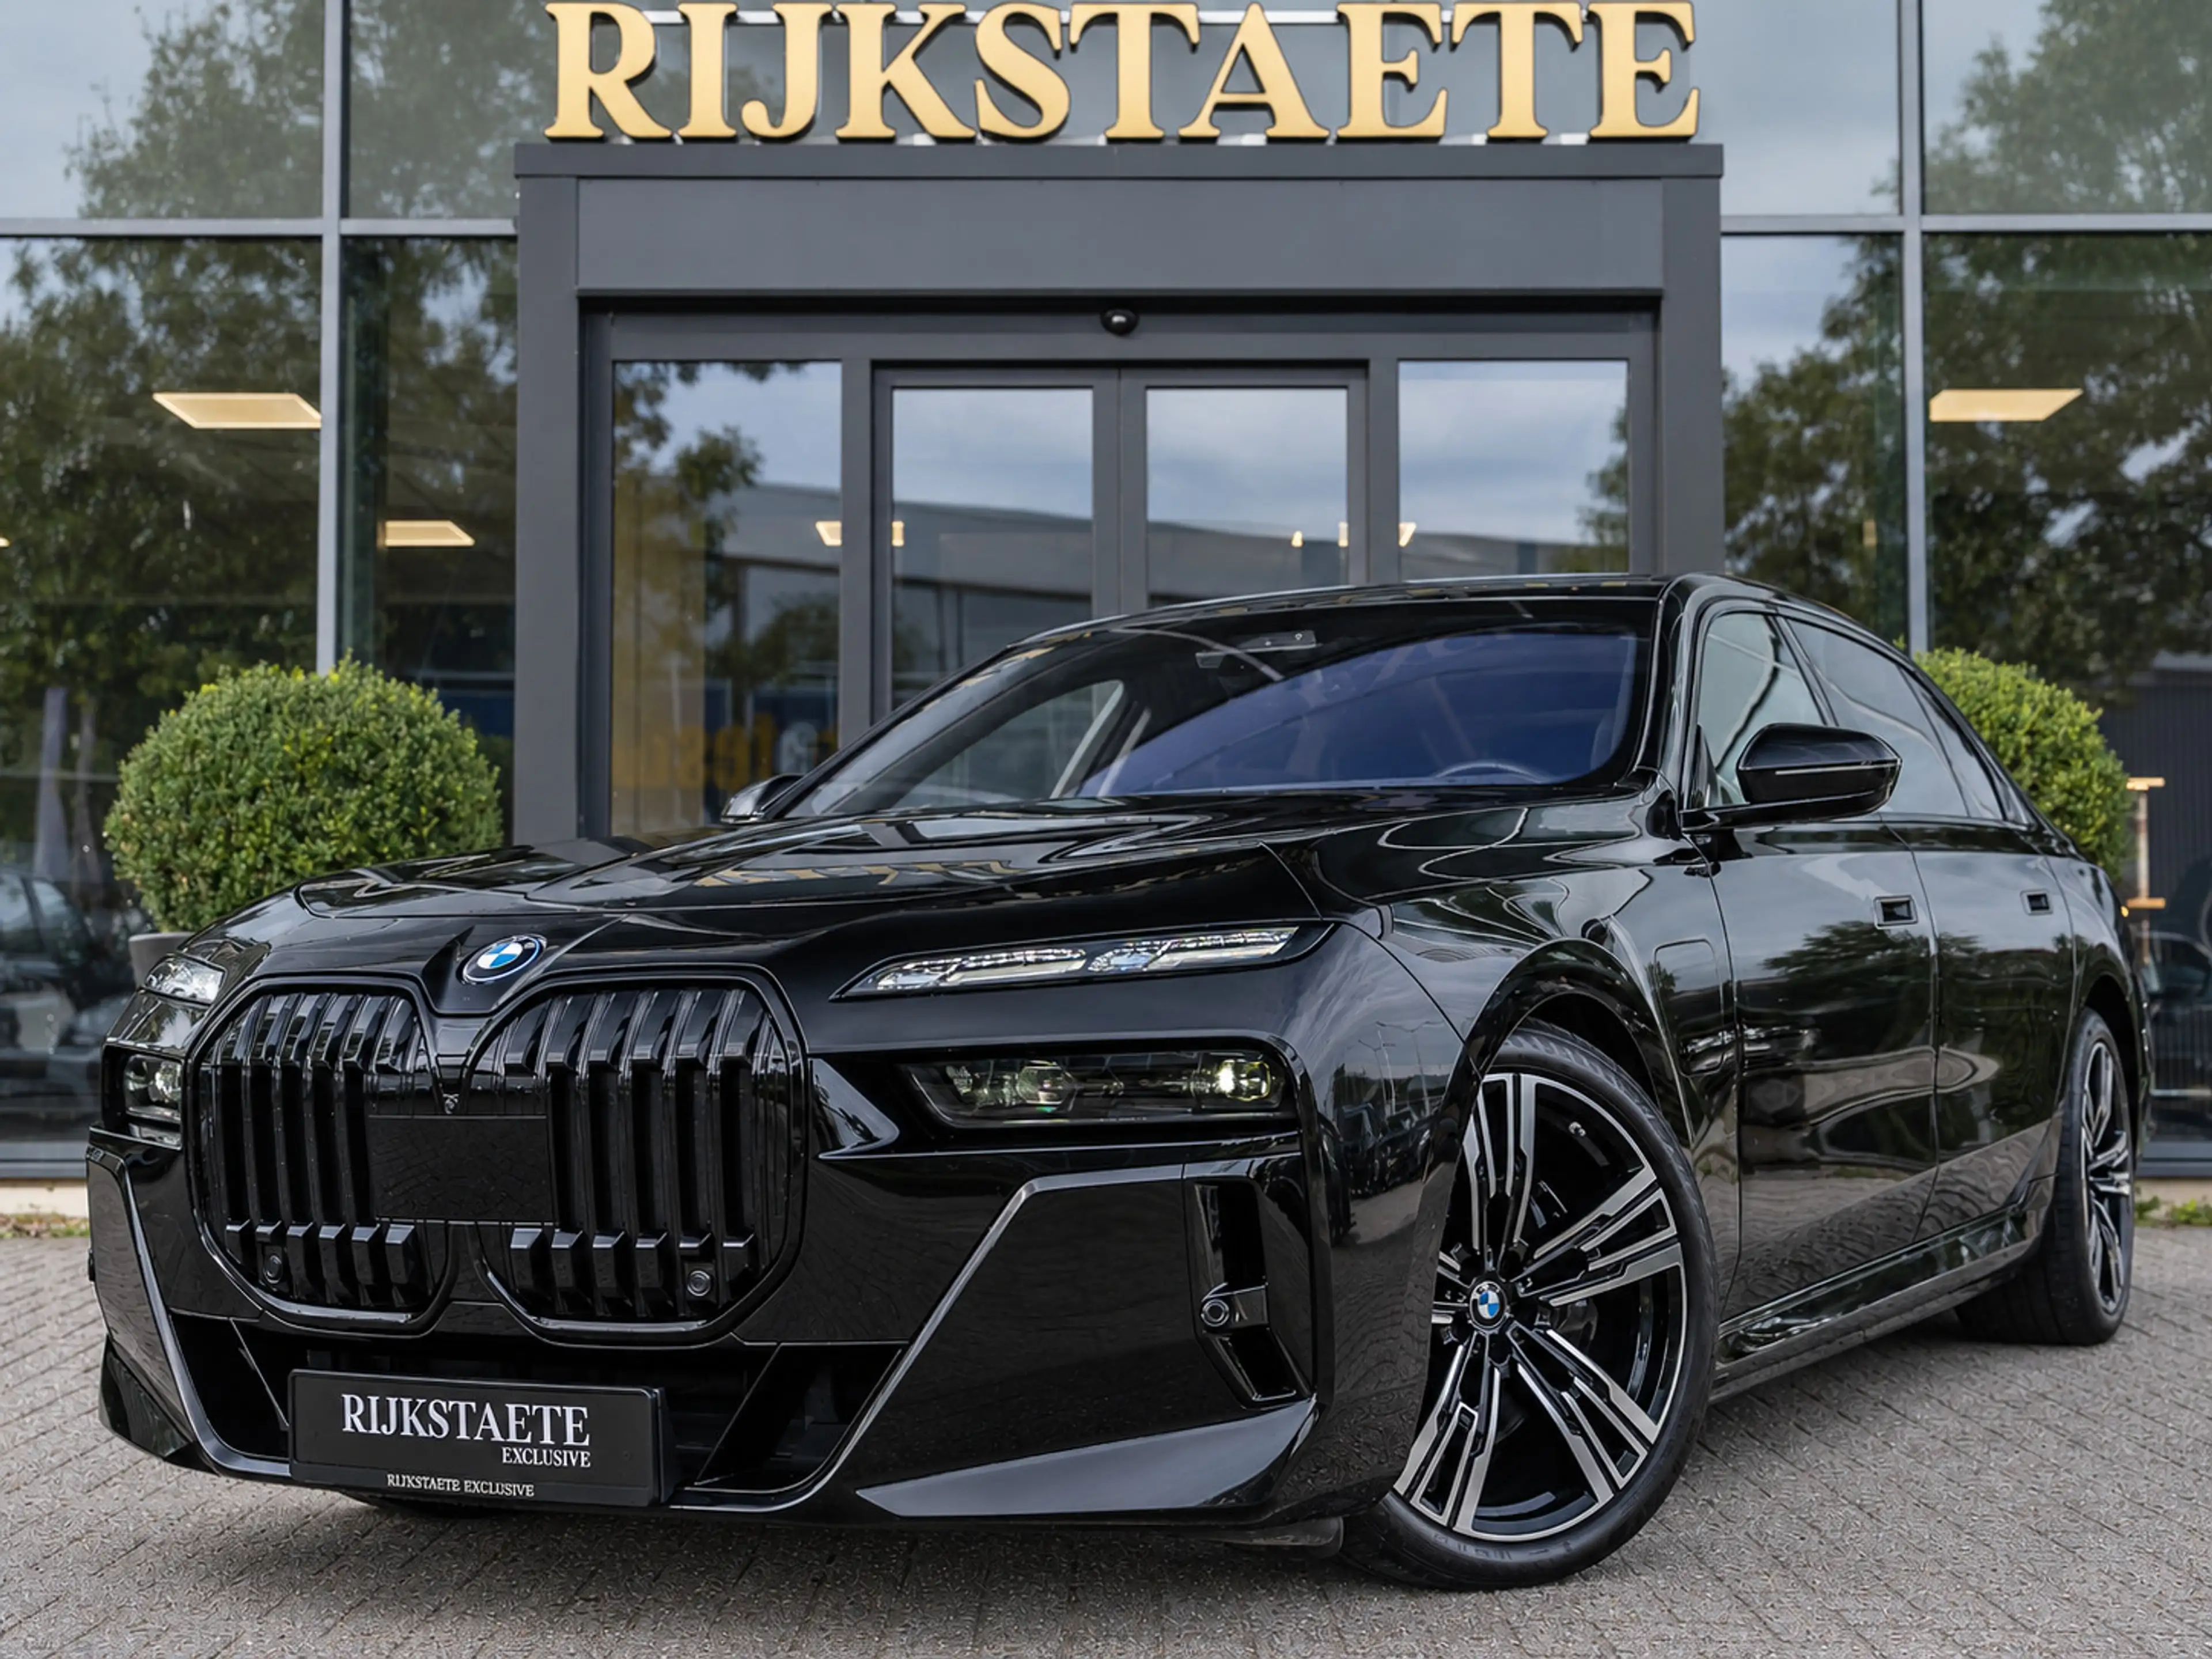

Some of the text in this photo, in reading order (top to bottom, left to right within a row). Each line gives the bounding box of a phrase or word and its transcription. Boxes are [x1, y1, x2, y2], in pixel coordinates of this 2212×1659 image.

[544, 1, 1700, 142] RIJKSTAETE
[341, 1393, 590, 1446] RIJKSTAETE
[502, 1446, 591, 1468] EXCLUSIVE
[387, 1474, 535, 1497] RIJKSTAETE EXCLUSIVE
